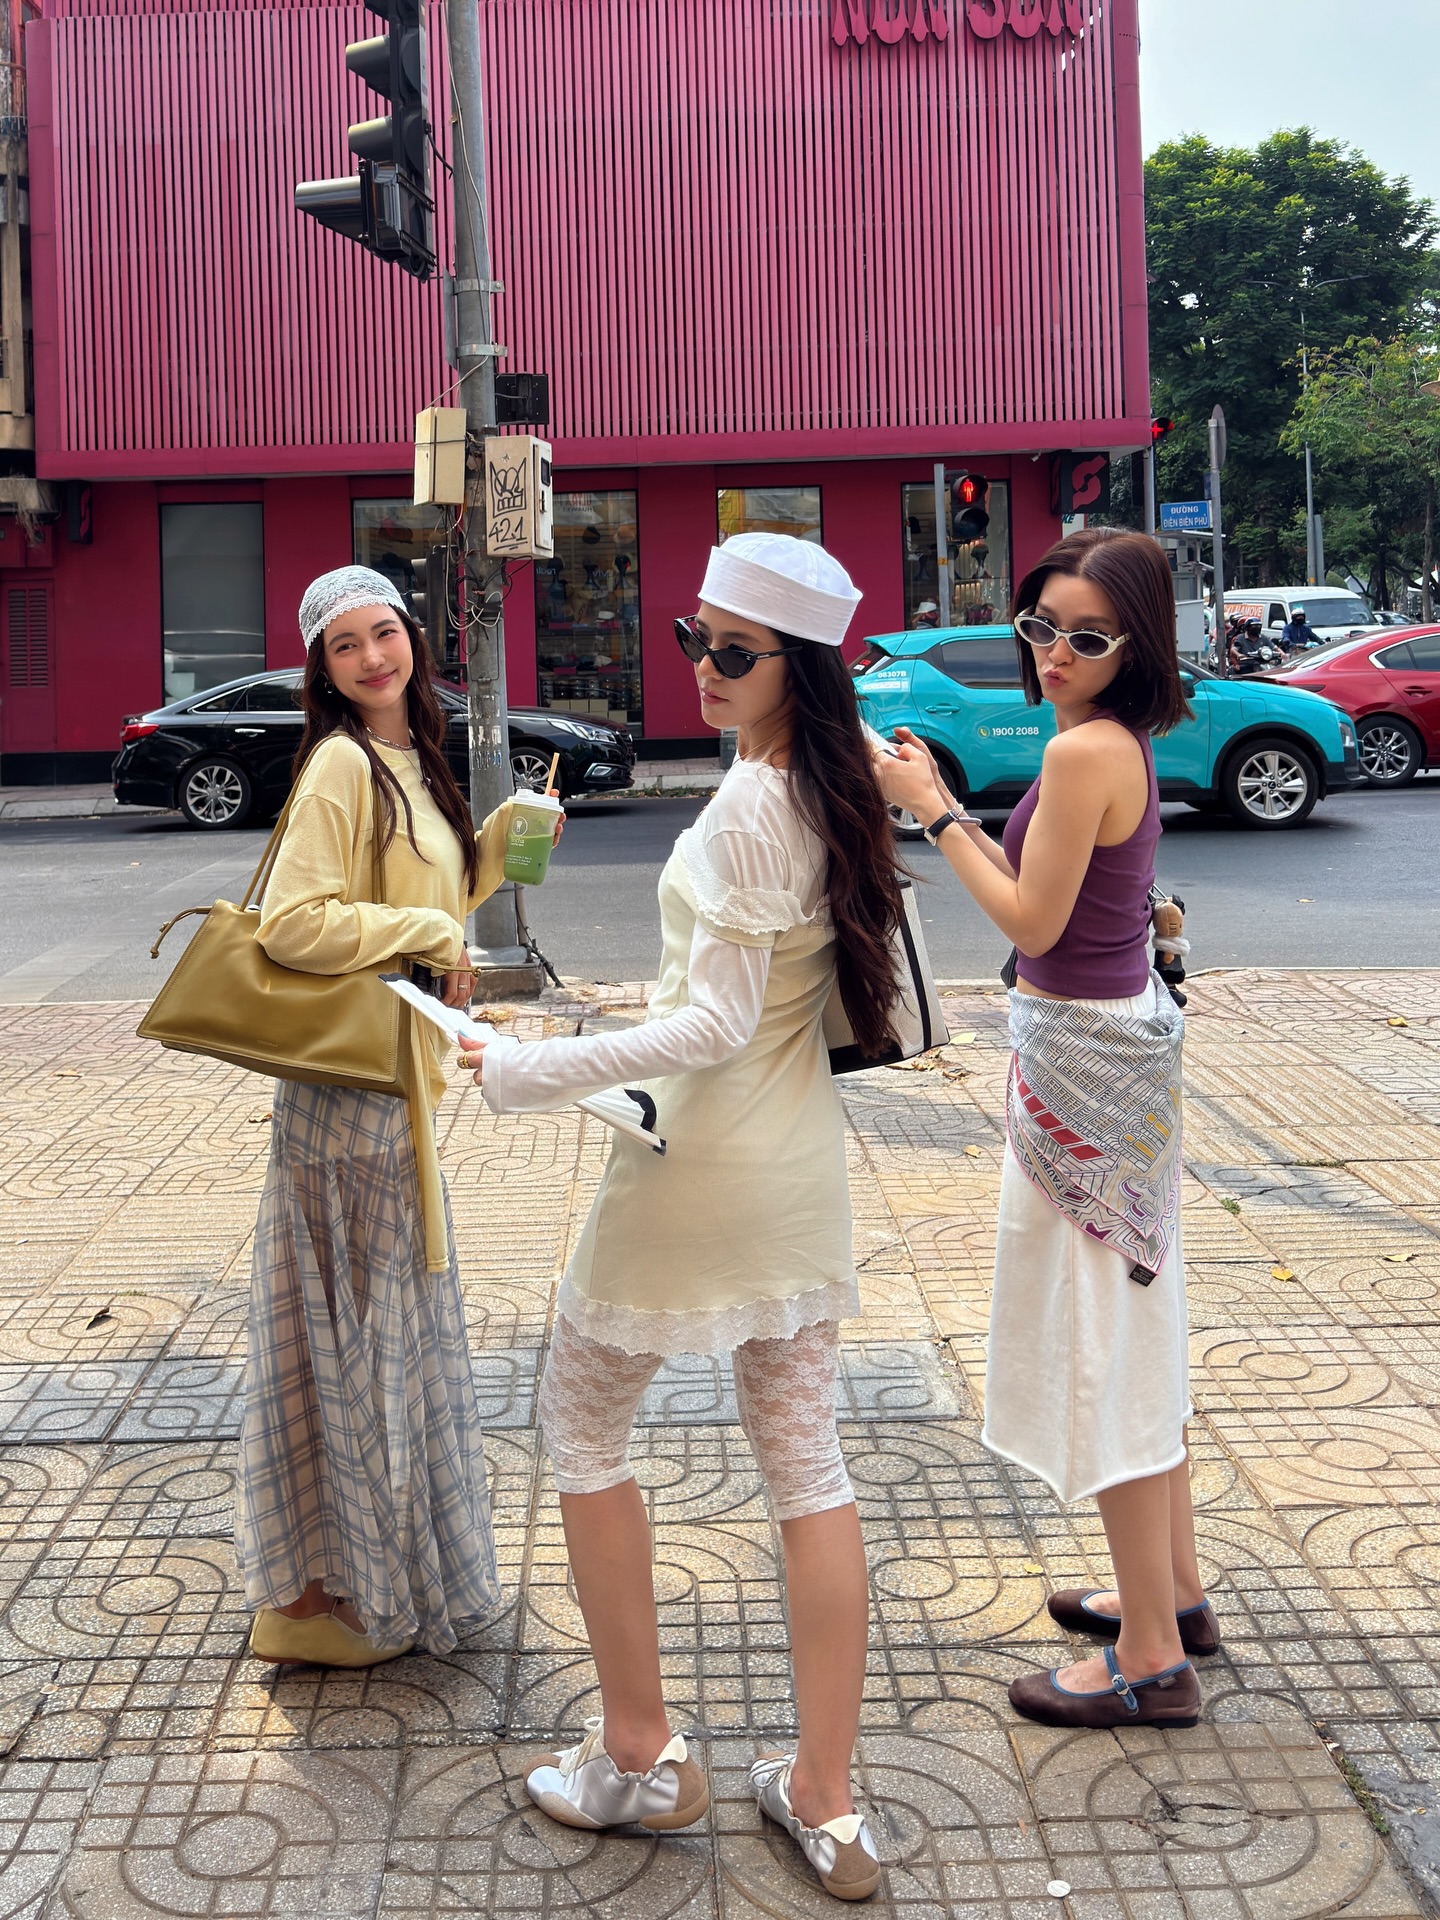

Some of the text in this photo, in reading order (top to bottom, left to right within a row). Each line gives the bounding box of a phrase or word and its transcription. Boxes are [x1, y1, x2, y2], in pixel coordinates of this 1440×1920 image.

[1170, 505, 1199, 515] ĐƯỜNG
[992, 726, 1040, 736] 1900 2088
